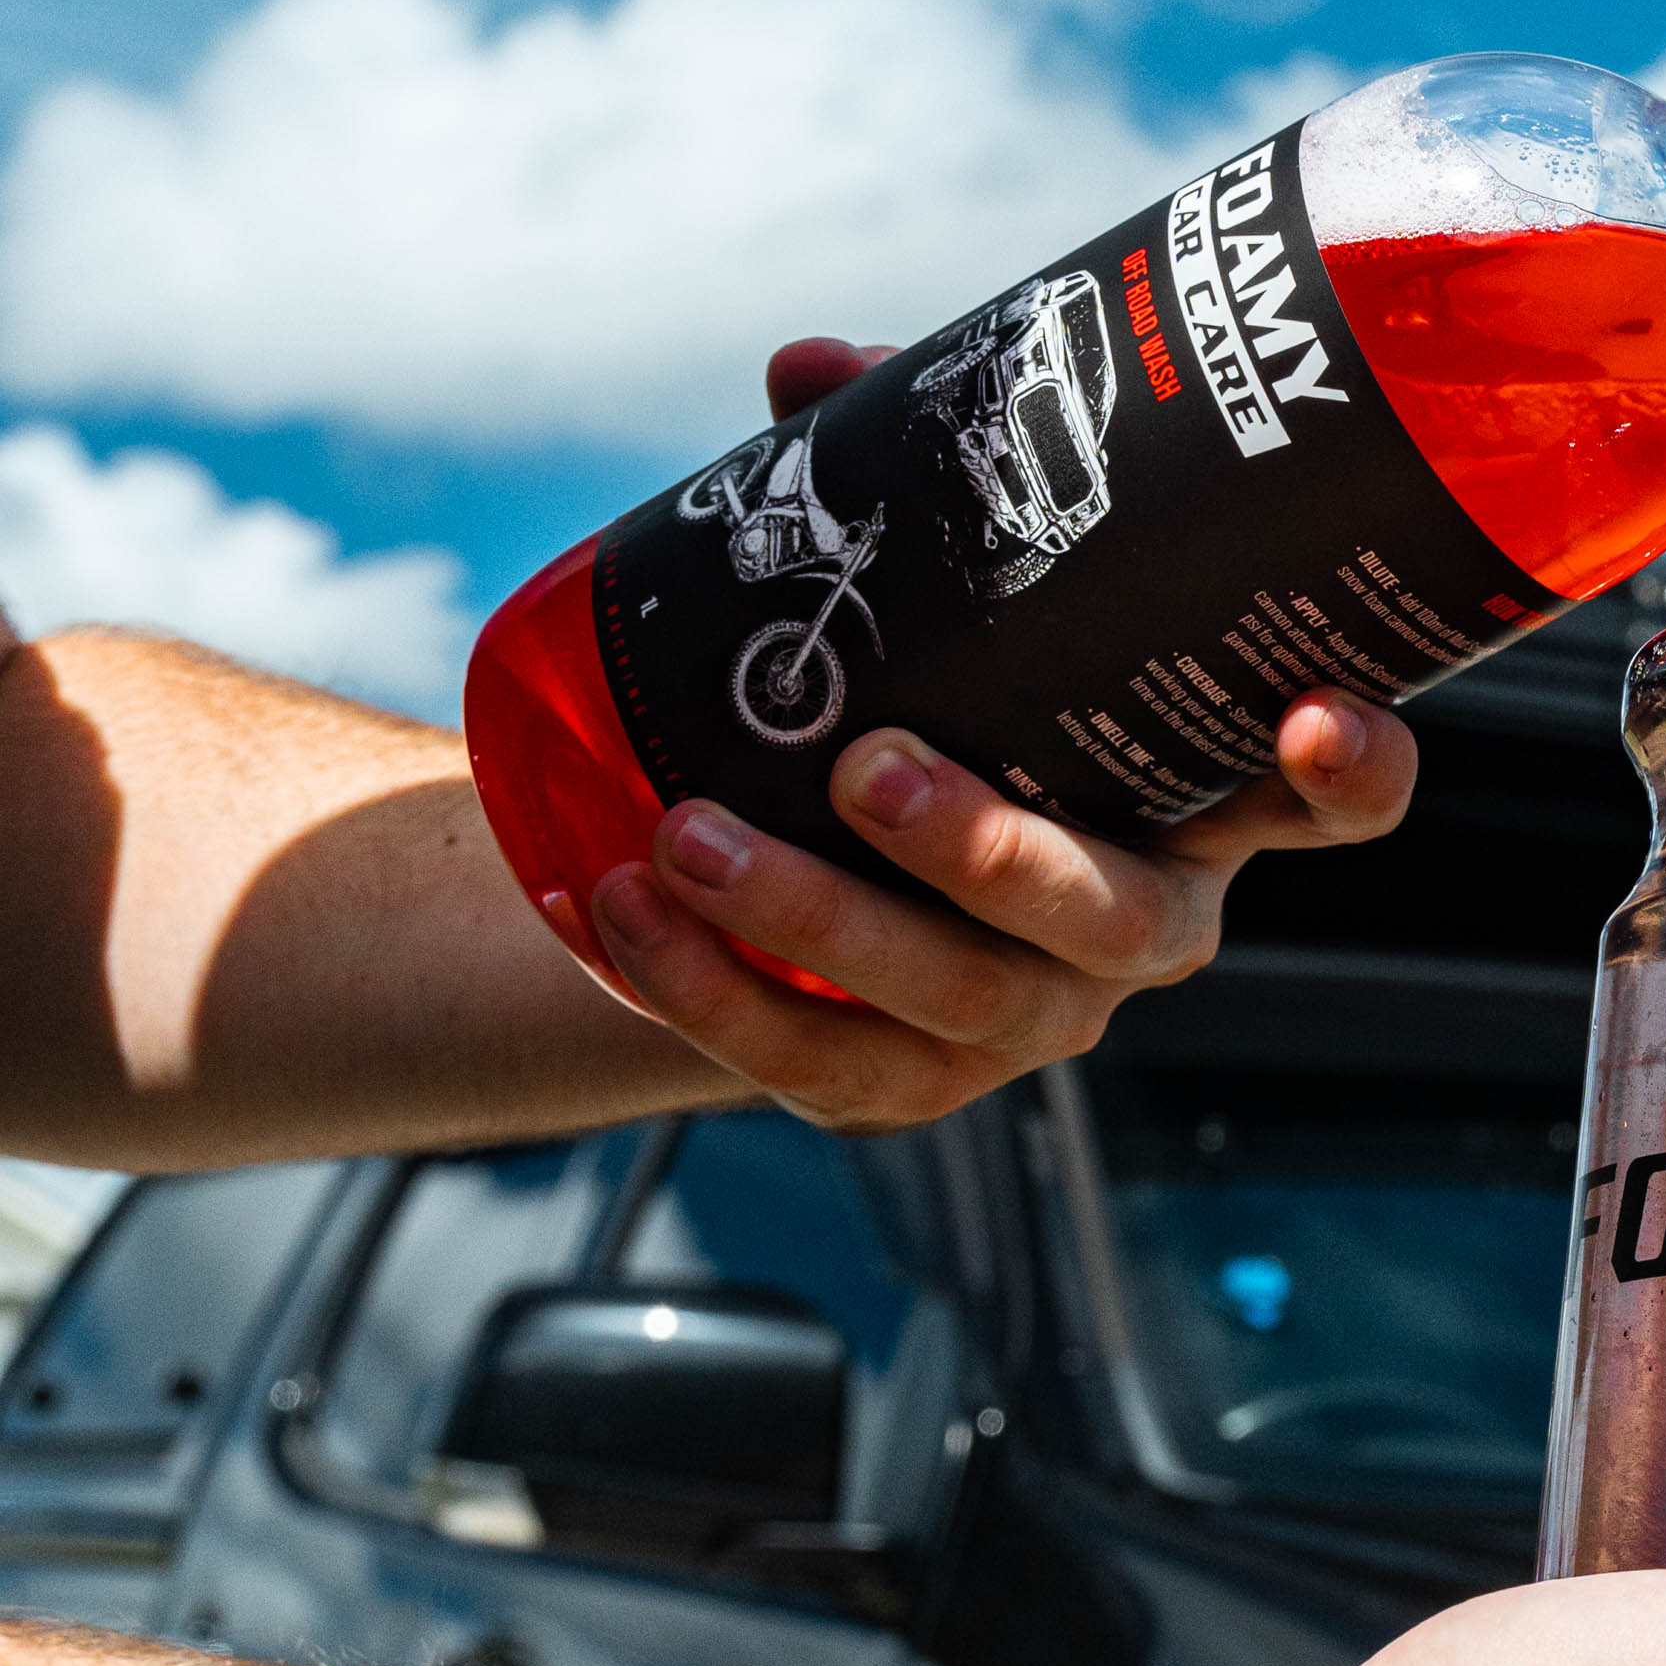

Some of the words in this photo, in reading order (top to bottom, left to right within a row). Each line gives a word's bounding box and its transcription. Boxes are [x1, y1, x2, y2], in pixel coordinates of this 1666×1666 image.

[1173, 184, 1204, 264] CAR
[1121, 247, 1150, 284] OFF
[1216, 140, 1351, 404] FOAMY
[1124, 279, 1160, 338] ROAD
[1137, 332, 1183, 404] WASH
[1184, 279, 1269, 435] CARE
[639, 595, 659, 619] 1L
[1336, 566, 1368, 593] snow
[1361, 591, 1390, 617] foam
[1383, 615, 1420, 642] cannon
[1357, 551, 1400, 589] DILUTE
[1395, 593, 1423, 612] Add
[1414, 608, 1447, 632] 100ml
[1480, 592, 1529, 622] HOW
[1221, 631, 1262, 666] garden
[1255, 661, 1283, 685] hose
[1237, 614, 1265, 632] psi
[1255, 629, 1276, 645] for
[1270, 645, 1312, 676] optimal
[1253, 591, 1292, 629] cannon
[1287, 628, 1335, 666] attached
[1325, 663, 1341, 673] to
[1290, 597, 1329, 627] APPLY
[1325, 632, 1356, 658] Apply
[1129, 677, 1155, 701] time
[1150, 700, 1168, 714] on
[1163, 711, 1184, 729] the
[1145, 659, 1187, 701] working
[1178, 697, 1208, 717] your
[1202, 716, 1225, 733] way
[1175, 656, 1231, 706] COVERAGE
[1228, 707, 1258, 729] Start
[1056, 710, 1092, 747] letting
[1086, 742, 1102, 754] it
[1094, 749, 1129, 778] loosen
[1090, 712, 1128, 747] DWELL
[1123, 743, 1154, 767] TIME
[1004, 766, 1043, 799] RINSE
